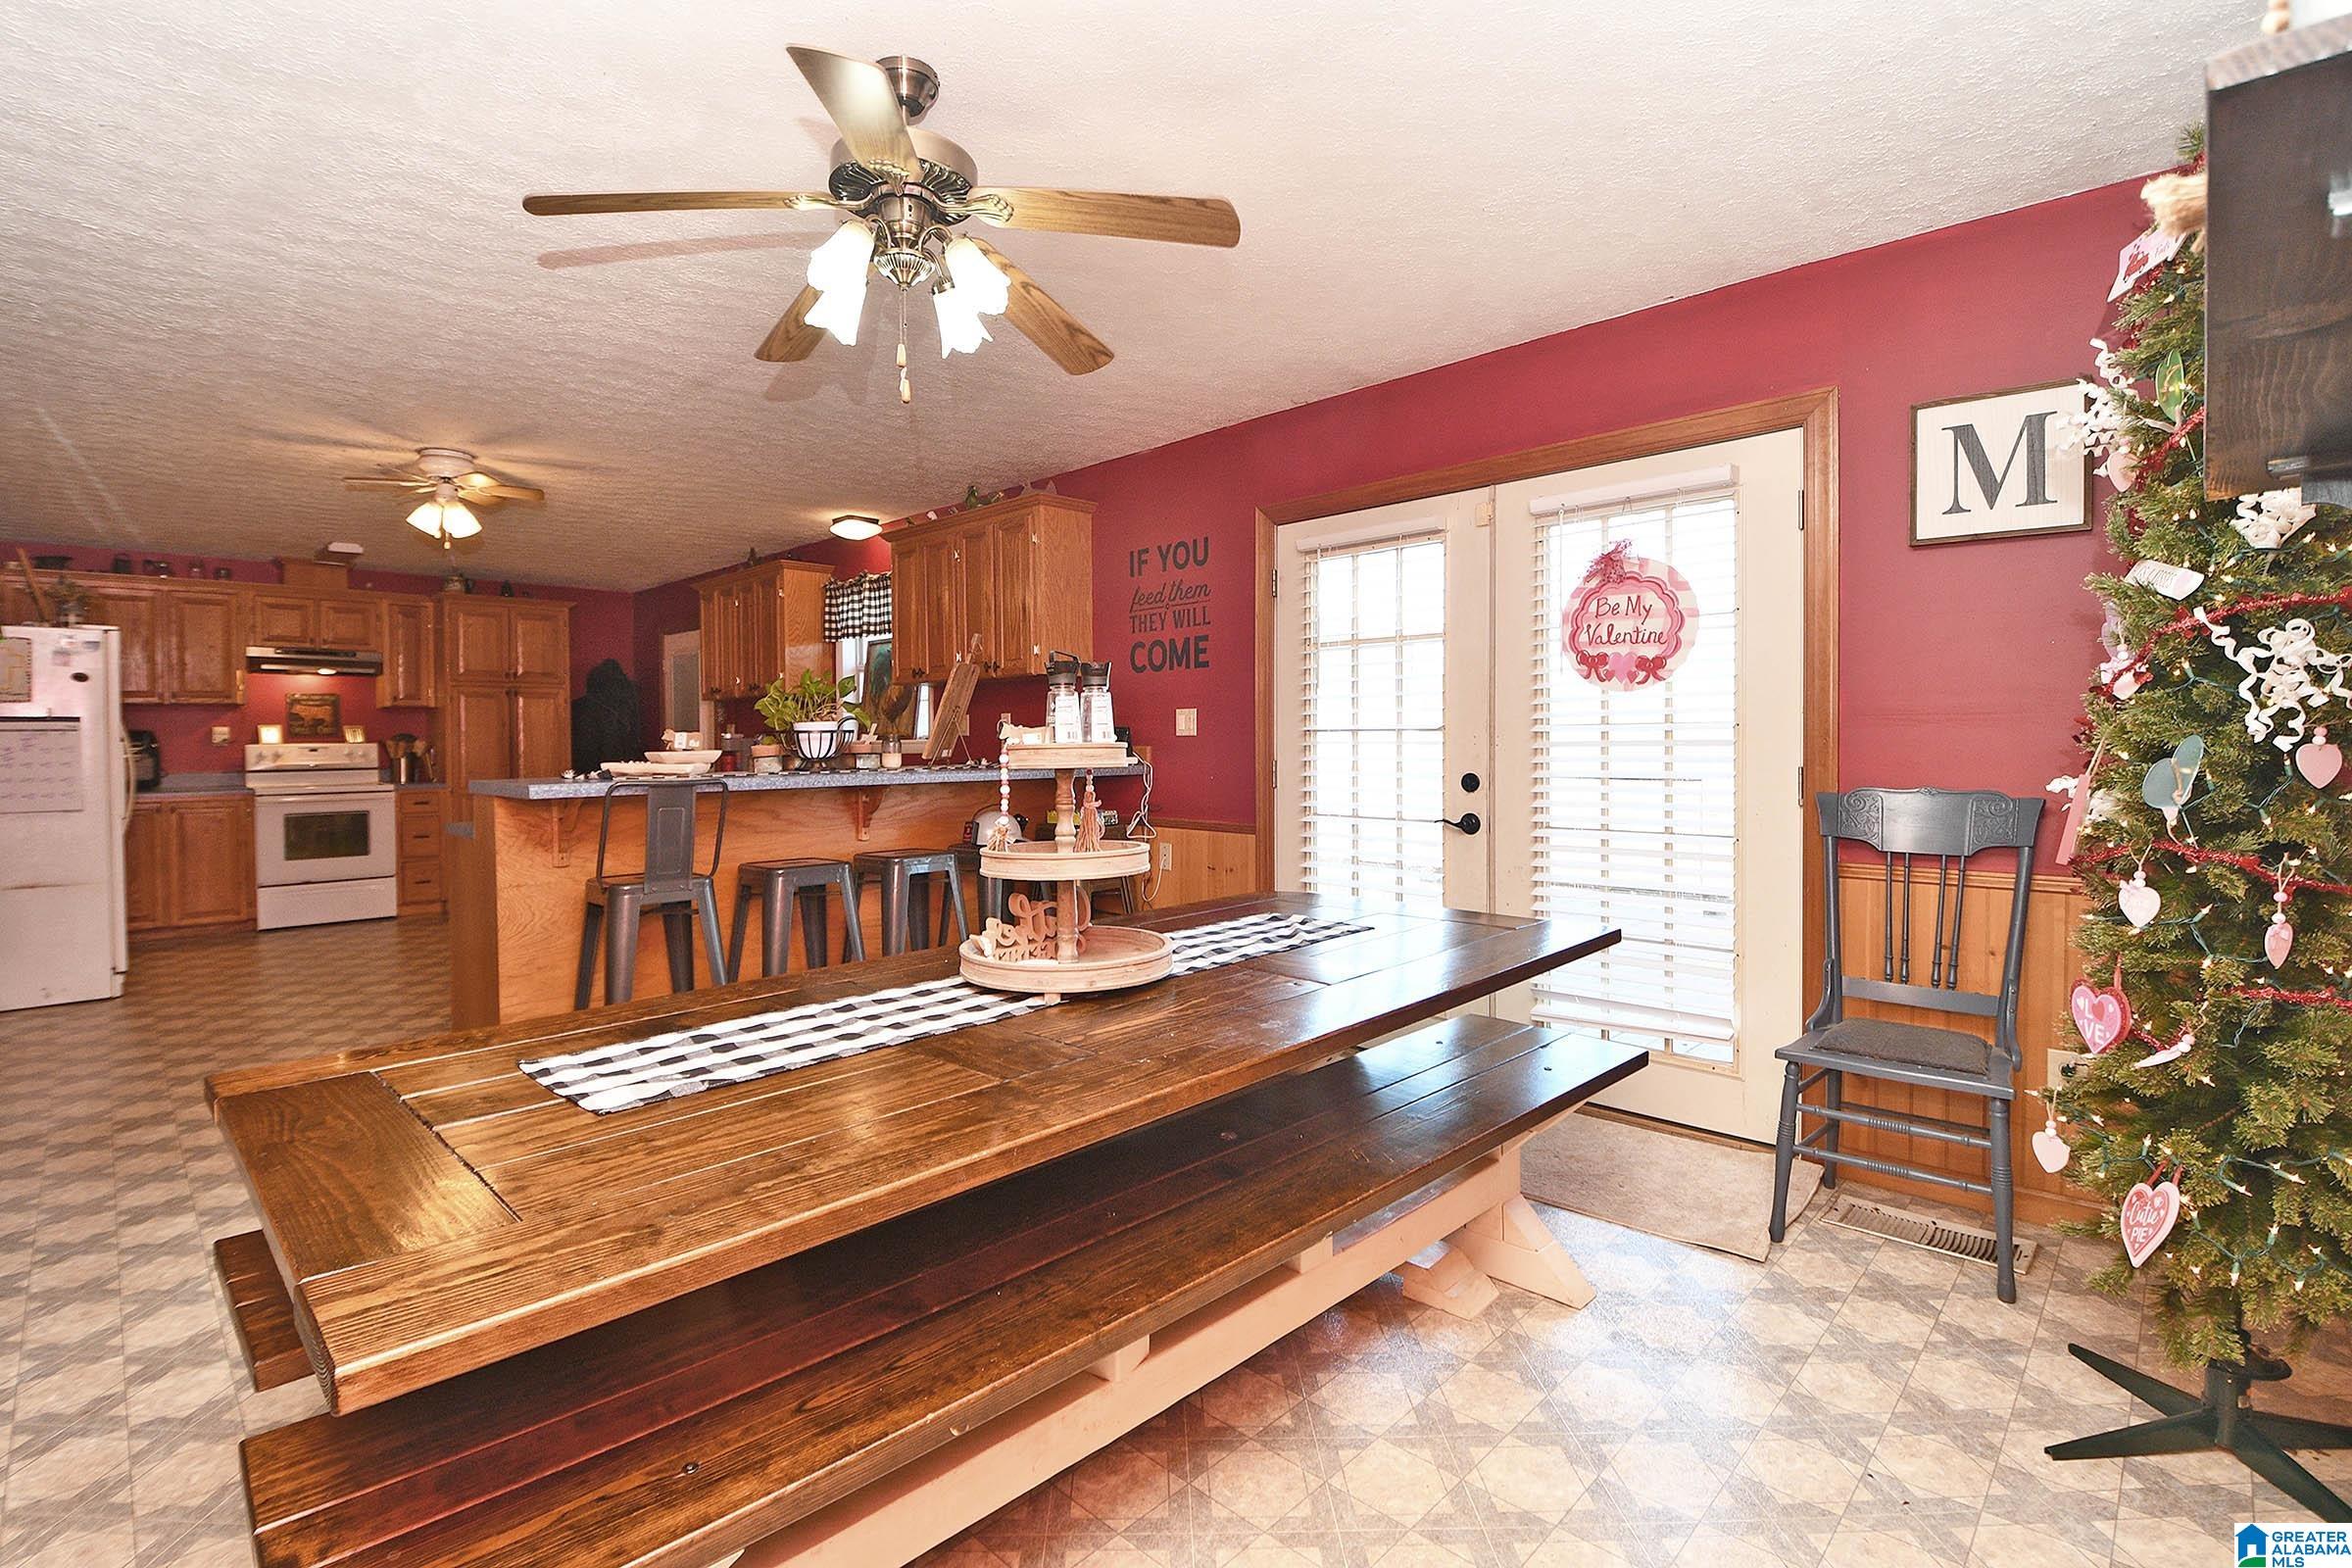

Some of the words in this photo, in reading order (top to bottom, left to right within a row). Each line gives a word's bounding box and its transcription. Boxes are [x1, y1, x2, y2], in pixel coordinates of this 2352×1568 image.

[1940, 410, 2058, 515] M
[1129, 547, 1150, 578] IF
[1156, 536, 1210, 572] YOU
[1129, 582, 1166, 612] feed
[1166, 577, 1212, 605] them
[1593, 596, 1620, 618] Be
[1625, 594, 1653, 625] My
[1129, 609, 1169, 635] THEY
[1172, 604, 1212, 629] WILL
[1584, 622, 1668, 647] Valentine
[1129, 634, 1210, 674] COME
